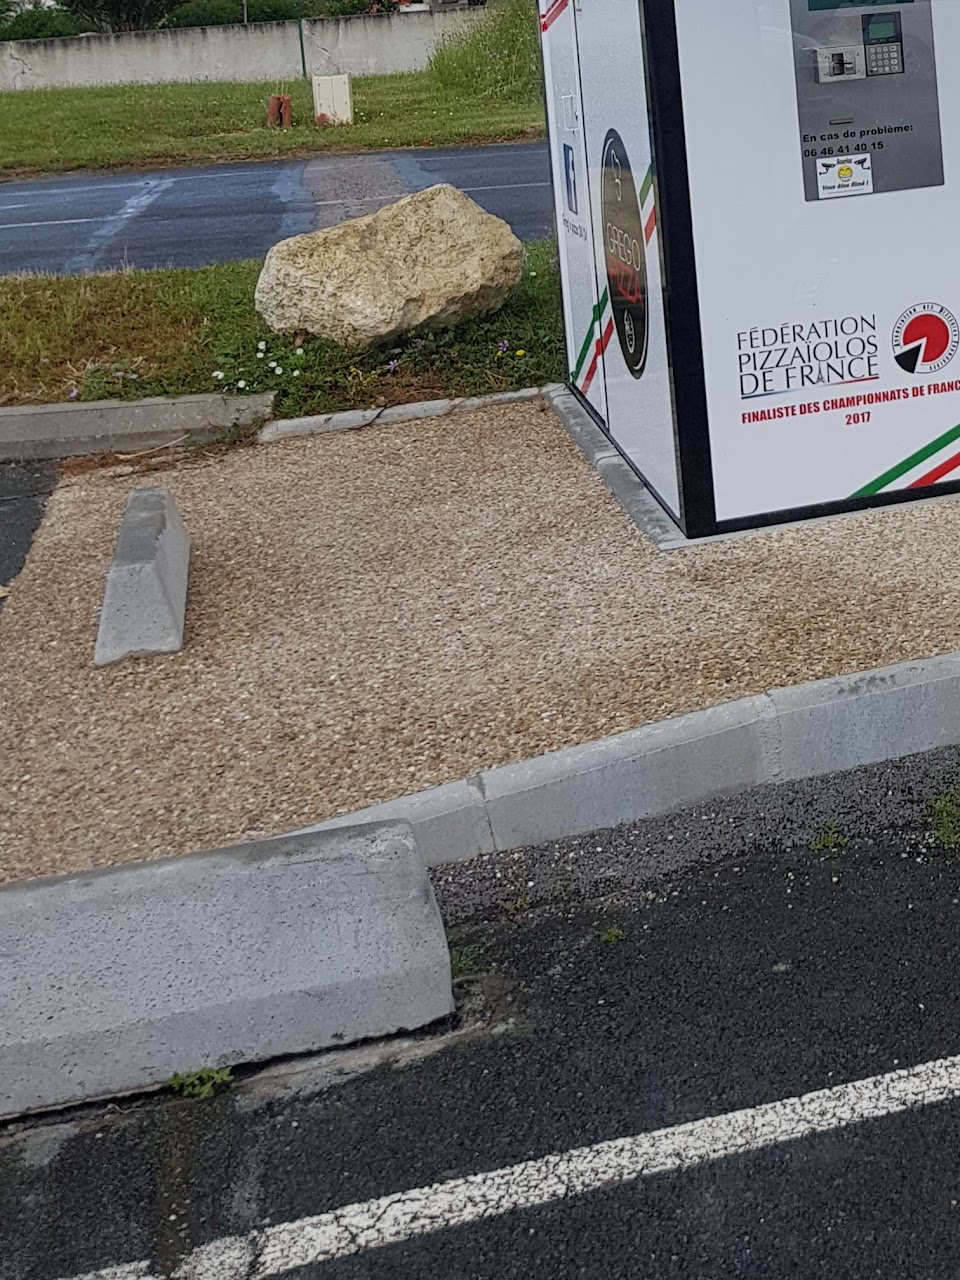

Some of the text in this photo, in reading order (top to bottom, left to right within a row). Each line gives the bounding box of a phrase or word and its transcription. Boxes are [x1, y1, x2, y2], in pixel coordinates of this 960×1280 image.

[803, 124, 914, 143] En cas de problème:
[803, 141, 884, 158] 06 46 41 40 15
[737, 314, 877, 351] FÉDÉRATION
[738, 333, 878, 373] PIZZAÏOLOS
[740, 354, 879, 396] DE FRANCE
[741, 405, 797, 424] FINALISTE
[799, 401, 821, 414] DES
[823, 388, 909, 411] CHAMPIONNATS
[912, 385, 925, 398] DE
[845, 411, 871, 425] 2017
